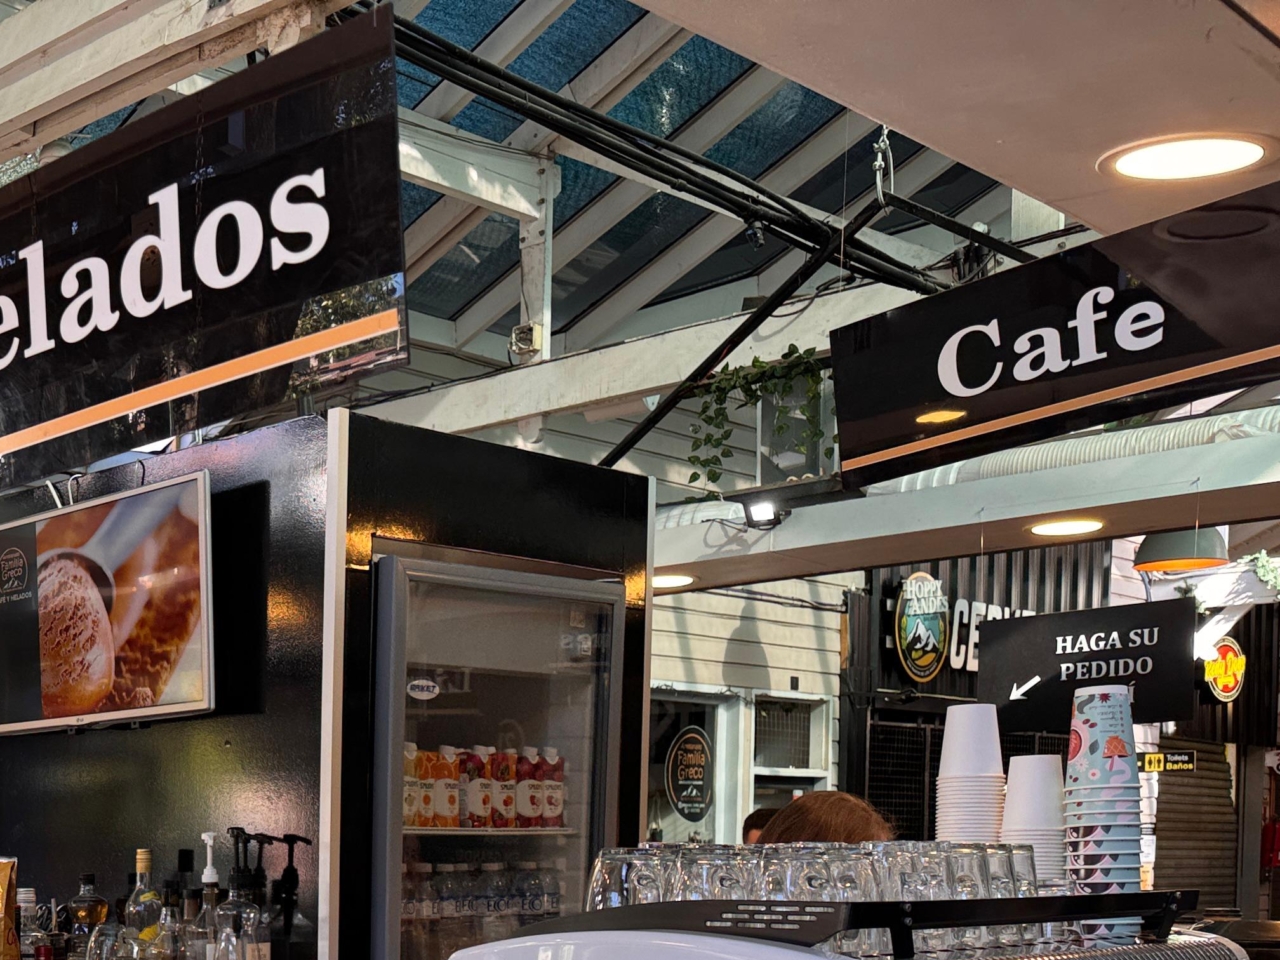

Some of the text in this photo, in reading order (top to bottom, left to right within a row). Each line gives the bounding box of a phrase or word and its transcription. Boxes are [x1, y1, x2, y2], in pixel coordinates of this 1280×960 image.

[937, 286, 1165, 397] Cafe
[906, 580, 942, 599] HOPPY
[910, 596, 949, 615] ANDES
[1055, 627, 1159, 654] HAGA SU
[1060, 656, 1153, 681] PEDIDO
[677, 750, 705, 765] Familia
[1166, 762, 1193, 770] Baños
[678, 766, 704, 780] Greco
